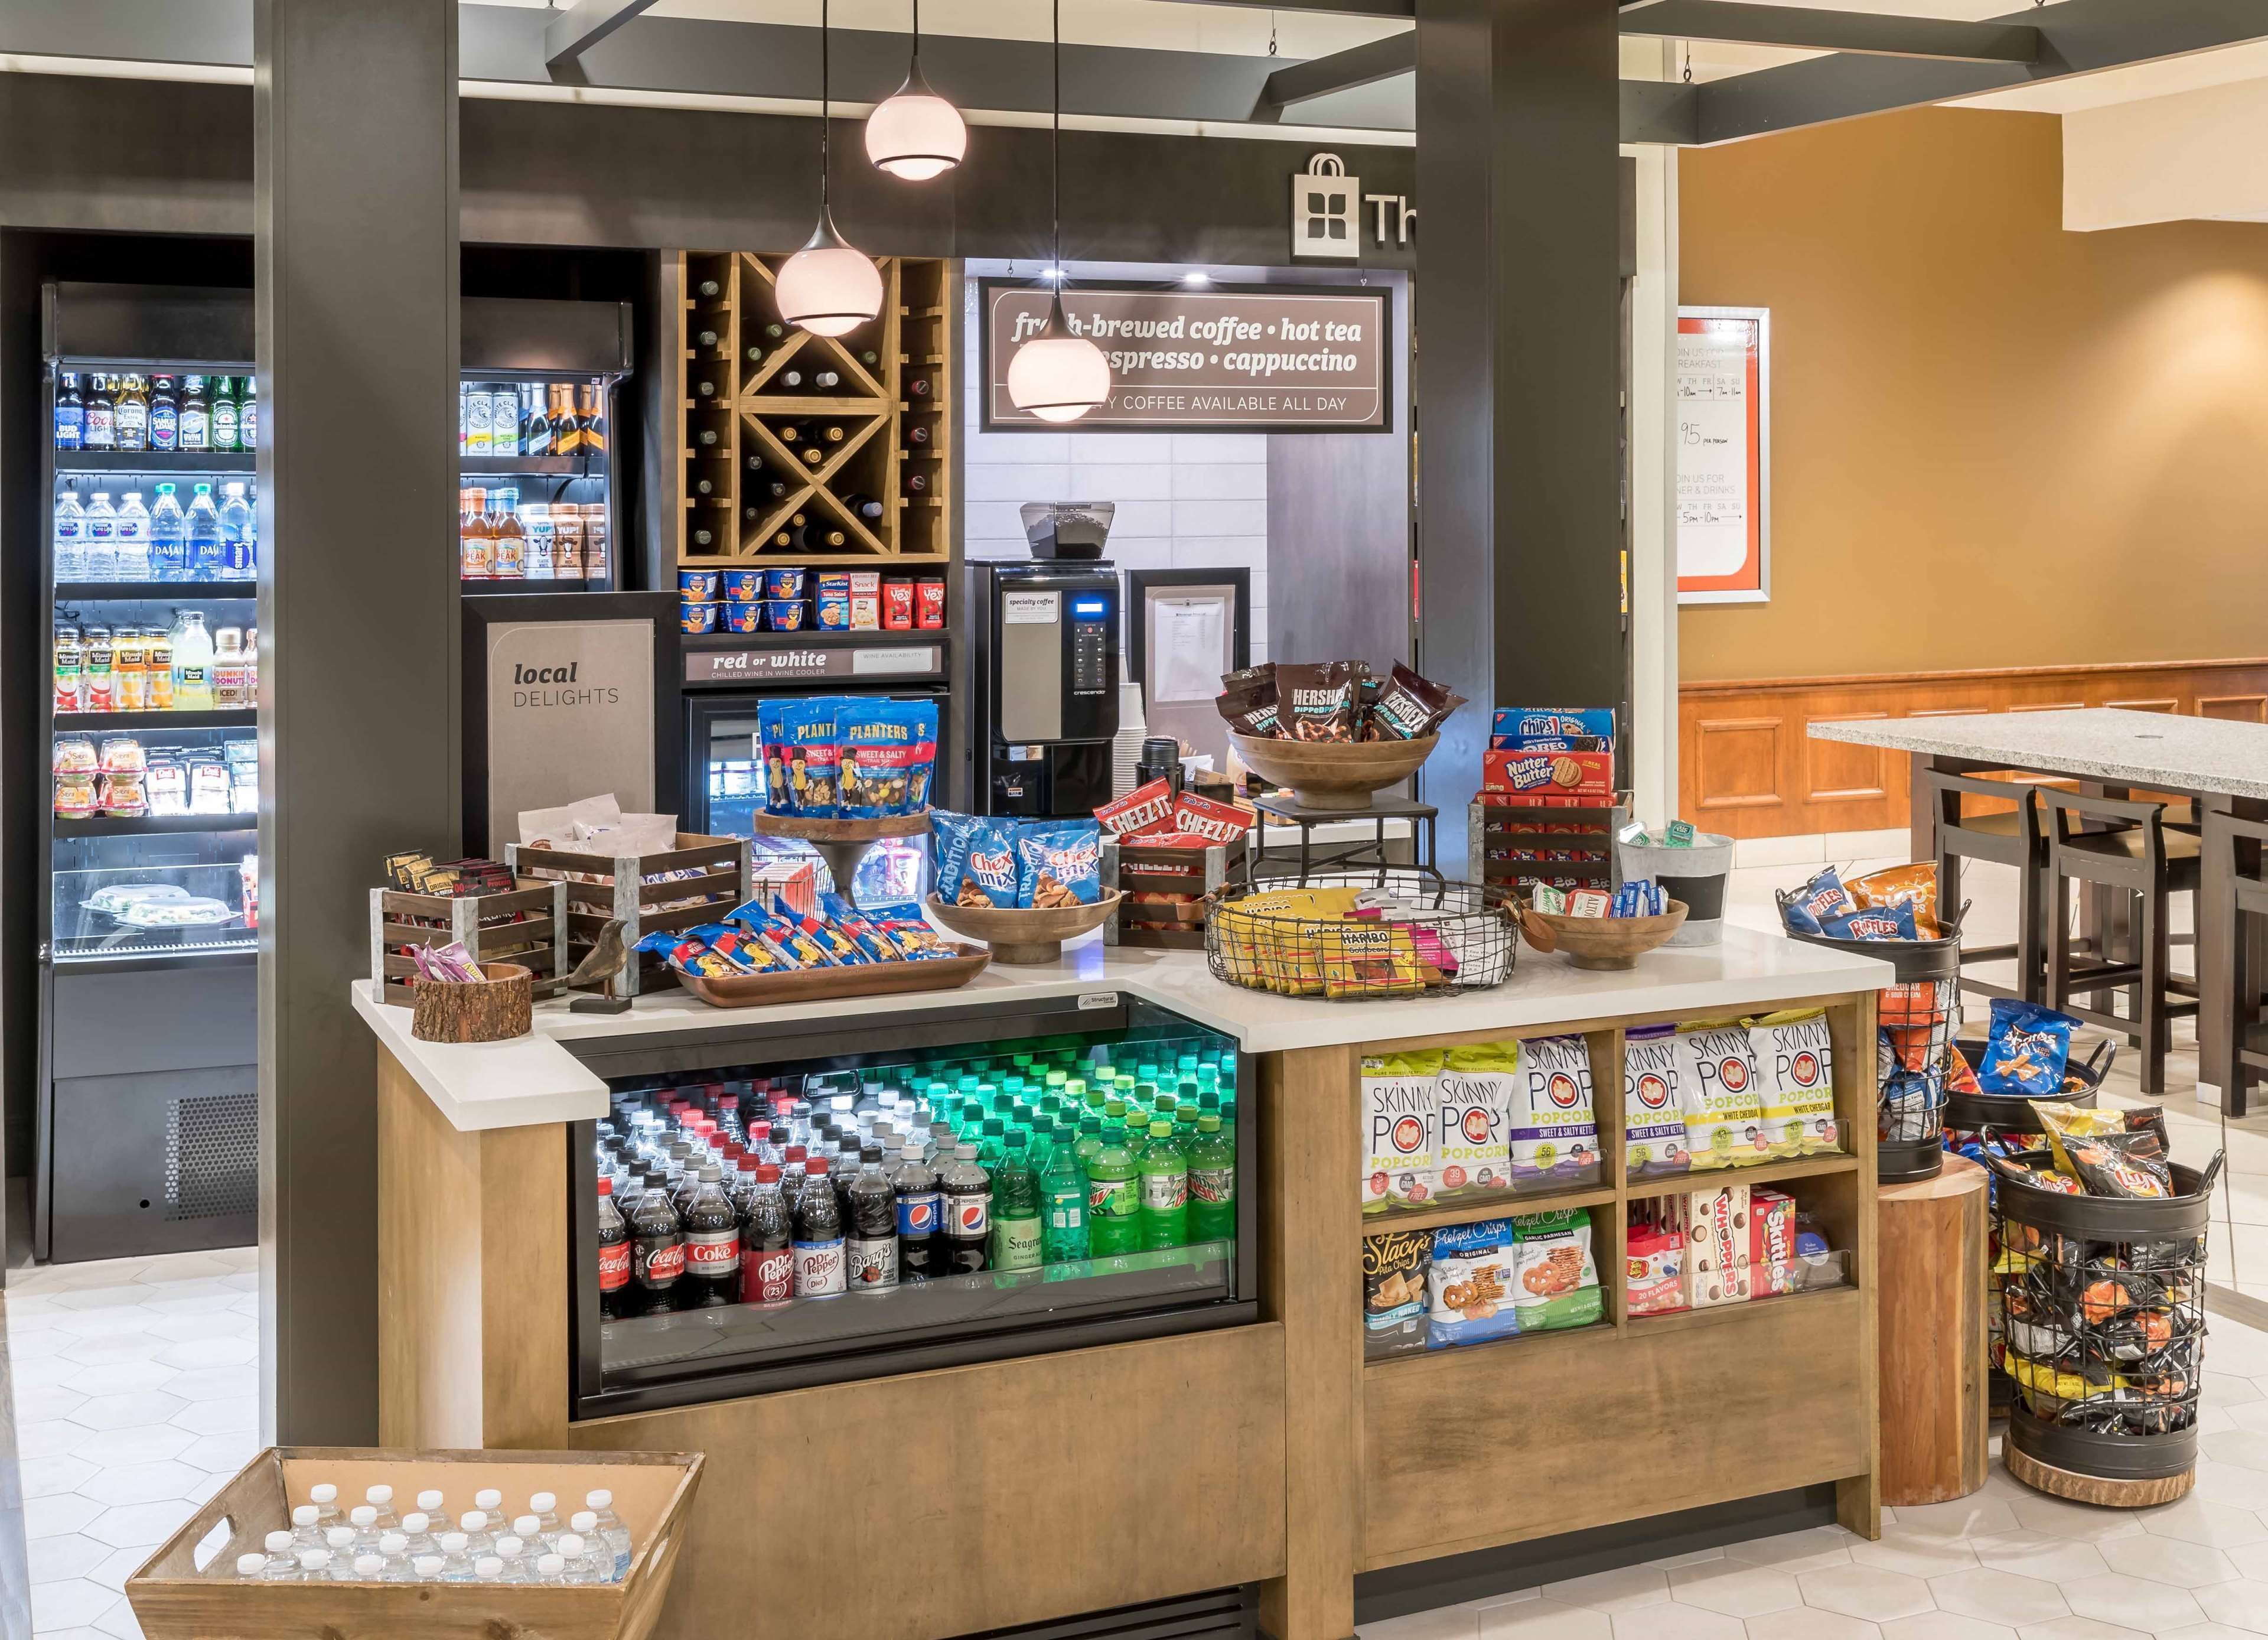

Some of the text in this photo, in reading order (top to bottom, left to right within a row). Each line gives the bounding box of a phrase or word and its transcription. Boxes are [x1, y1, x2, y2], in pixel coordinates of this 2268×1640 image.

[1011, 312, 1361, 345] frh-brewed coffee hot tea
[1103, 348, 1357, 376] spresso cappuccino
[1678, 359, 1721, 369] REAKFAST
[118, 406, 142, 415] Corona
[1123, 396, 1186, 411] COFFEE
[1191, 396, 1278, 411] AVAILABLE
[1282, 397, 1311, 411] ALL
[1317, 398, 1347, 412] DAY
[152, 416, 176, 425] SAMUEL
[155, 423, 175, 431] ADAMS
[1693, 474, 1725, 483] US FOR
[1695, 486, 1735, 494] & DRINKS
[891, 588, 911, 601] Yes!
[924, 588, 944, 601] Yes!
[713, 650, 827, 669] red or white
[514, 662, 578, 685] local
[514, 688, 619, 707] DELIGHTS
[849, 723, 908, 740] PLANTERS
[1520, 715, 1586, 735] Chips ORIGINAL
[806, 749, 827, 757] SWEET
[856, 750, 878, 758] SWEET
[886, 750, 906, 758] SALTY
[1506, 757, 1547, 777] Nutter
[1514, 766, 1553, 789] Butter
[1183, 796, 1196, 806] Grab
[970, 851, 1014, 871] Chex
[978, 865, 1017, 886] mix
[1807, 888, 1843, 916] RUFFLES
[1848, 919, 1898, 940] RUFFLES
[1772, 1021, 1829, 1053] SKINNY
[1527, 1042, 1588, 1069] SKINNY
[1776, 1047, 1832, 1092] POP
[1441, 1076, 1503, 1104] SKINNY
[1528, 1069, 1594, 1111] POP
[1373, 1082, 1432, 1113] SKINNY
[1722, 1111, 1739, 1121] WHITE
[1793, 1105, 1810, 1114] WHITE
[1539, 1125, 1594, 1138] SWEET & SALTY KETTLE
[1631, 1125, 1670, 1138] SWEET & SALTY
[1441, 1146, 1510, 1159] POPCORN
[1541, 1147, 1550, 1157] 56
[1635, 1148, 1646, 1157] 56
[1449, 1169, 1461, 1179] 39
[1478, 1174, 1491, 1182] GMO
[1401, 1180, 1413, 1189] GMO
[1410, 1191, 1426, 1200] FREE
[1431, 1221, 1507, 1248] Pretzel Crisps
[1543, 1231, 1572, 1241] PARMESAN
[693, 1245, 731, 1261] Coke
[816, 1253, 829, 1262] Dr
[1459, 1248, 1491, 1258] ORIGINAL
[1767, 1211, 1788, 1291] Skittles
[775, 1255, 790, 1267] Dr
[807, 1255, 838, 1275] Pepper
[850, 1242, 892, 1280] Barq's
[1379, 1258, 1410, 1275] Pita Chips
[762, 1257, 794, 1283] Pepper
[810, 1278, 823, 1288] Diet
[1638, 1280, 1678, 1300] 20 FLAVORS
[770, 1287, 780, 1296] 23
